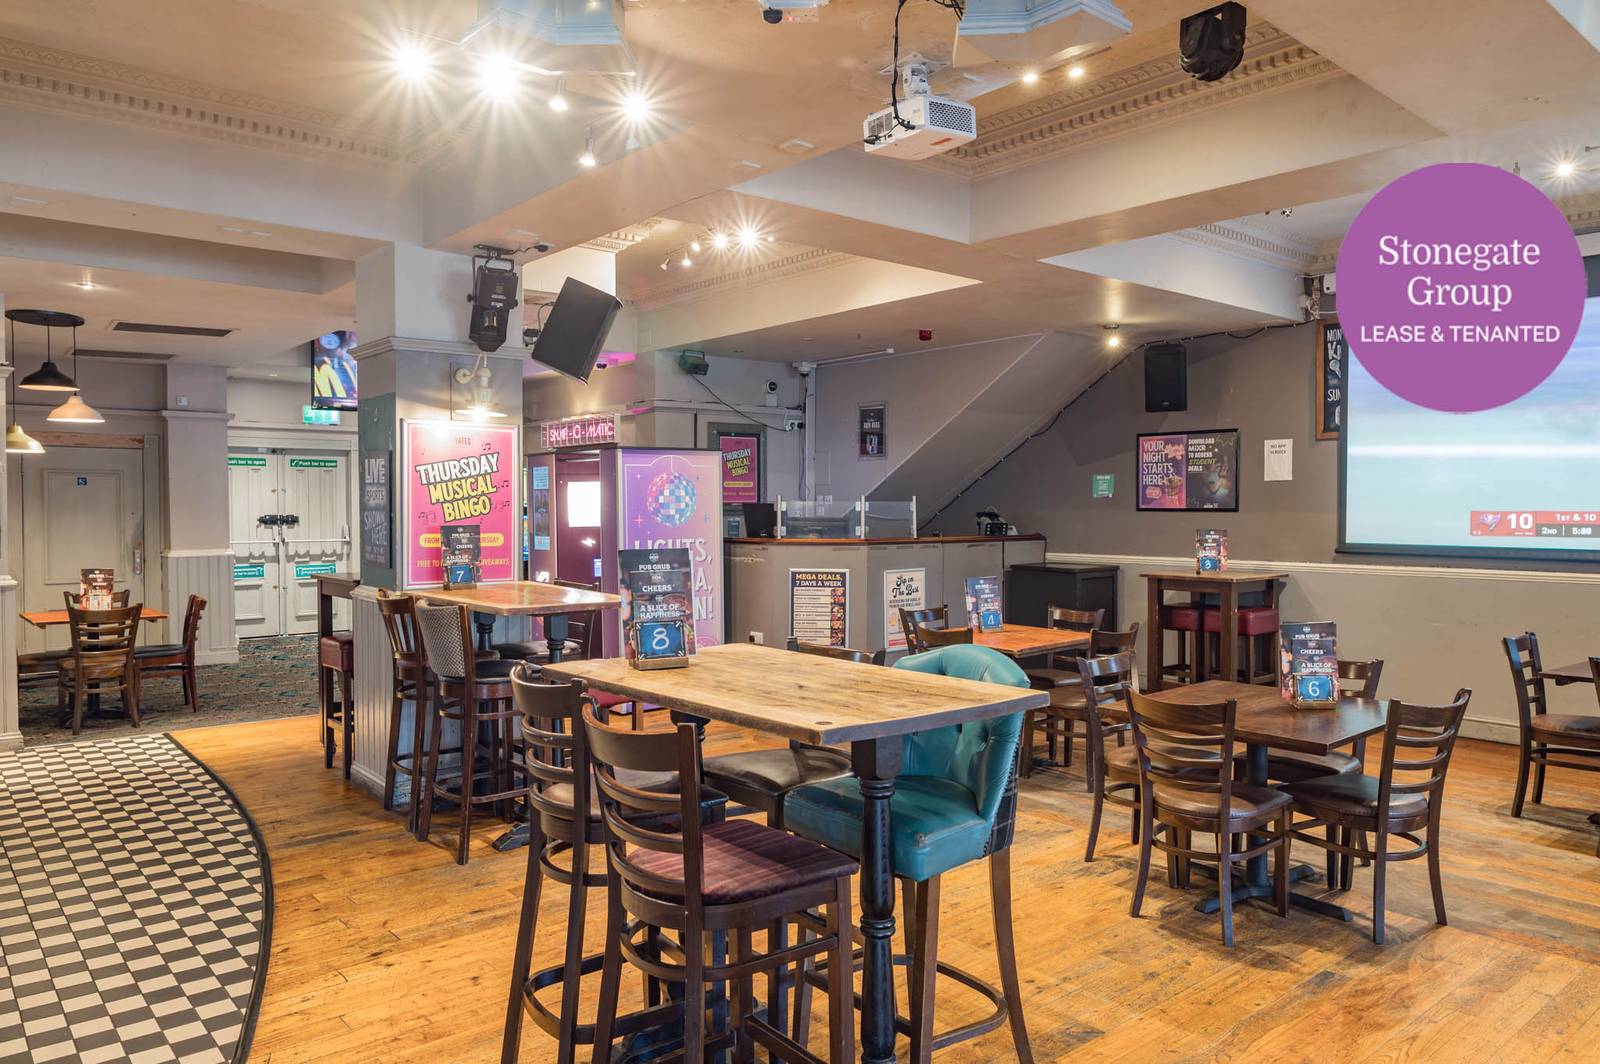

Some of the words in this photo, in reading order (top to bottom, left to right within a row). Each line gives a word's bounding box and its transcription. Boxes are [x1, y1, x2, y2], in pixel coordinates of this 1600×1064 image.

[1143, 440, 1164, 452] YOUR
[723, 448, 751, 461] THURSDAY
[1143, 451, 1166, 462] NIGHT
[415, 452, 499, 485] THURSDAY
[727, 457, 751, 469] MUSICAL
[1143, 462, 1174, 474] STARTS
[364, 458, 385, 484] LIVE
[1143, 474, 1163, 485] HERE
[428, 473, 498, 504] MUSICAL
[442, 495, 491, 522] BINGO
[1507, 513, 1533, 529] 10
[1584, 514, 1596, 522] 10
[416, 559, 432, 568] FREE
[432, 559, 440, 567] TO
[1204, 560, 1212, 569] 3
[456, 570, 464, 582] 7
[652, 627, 670, 650] 8
[1308, 681, 1320, 697] 6
